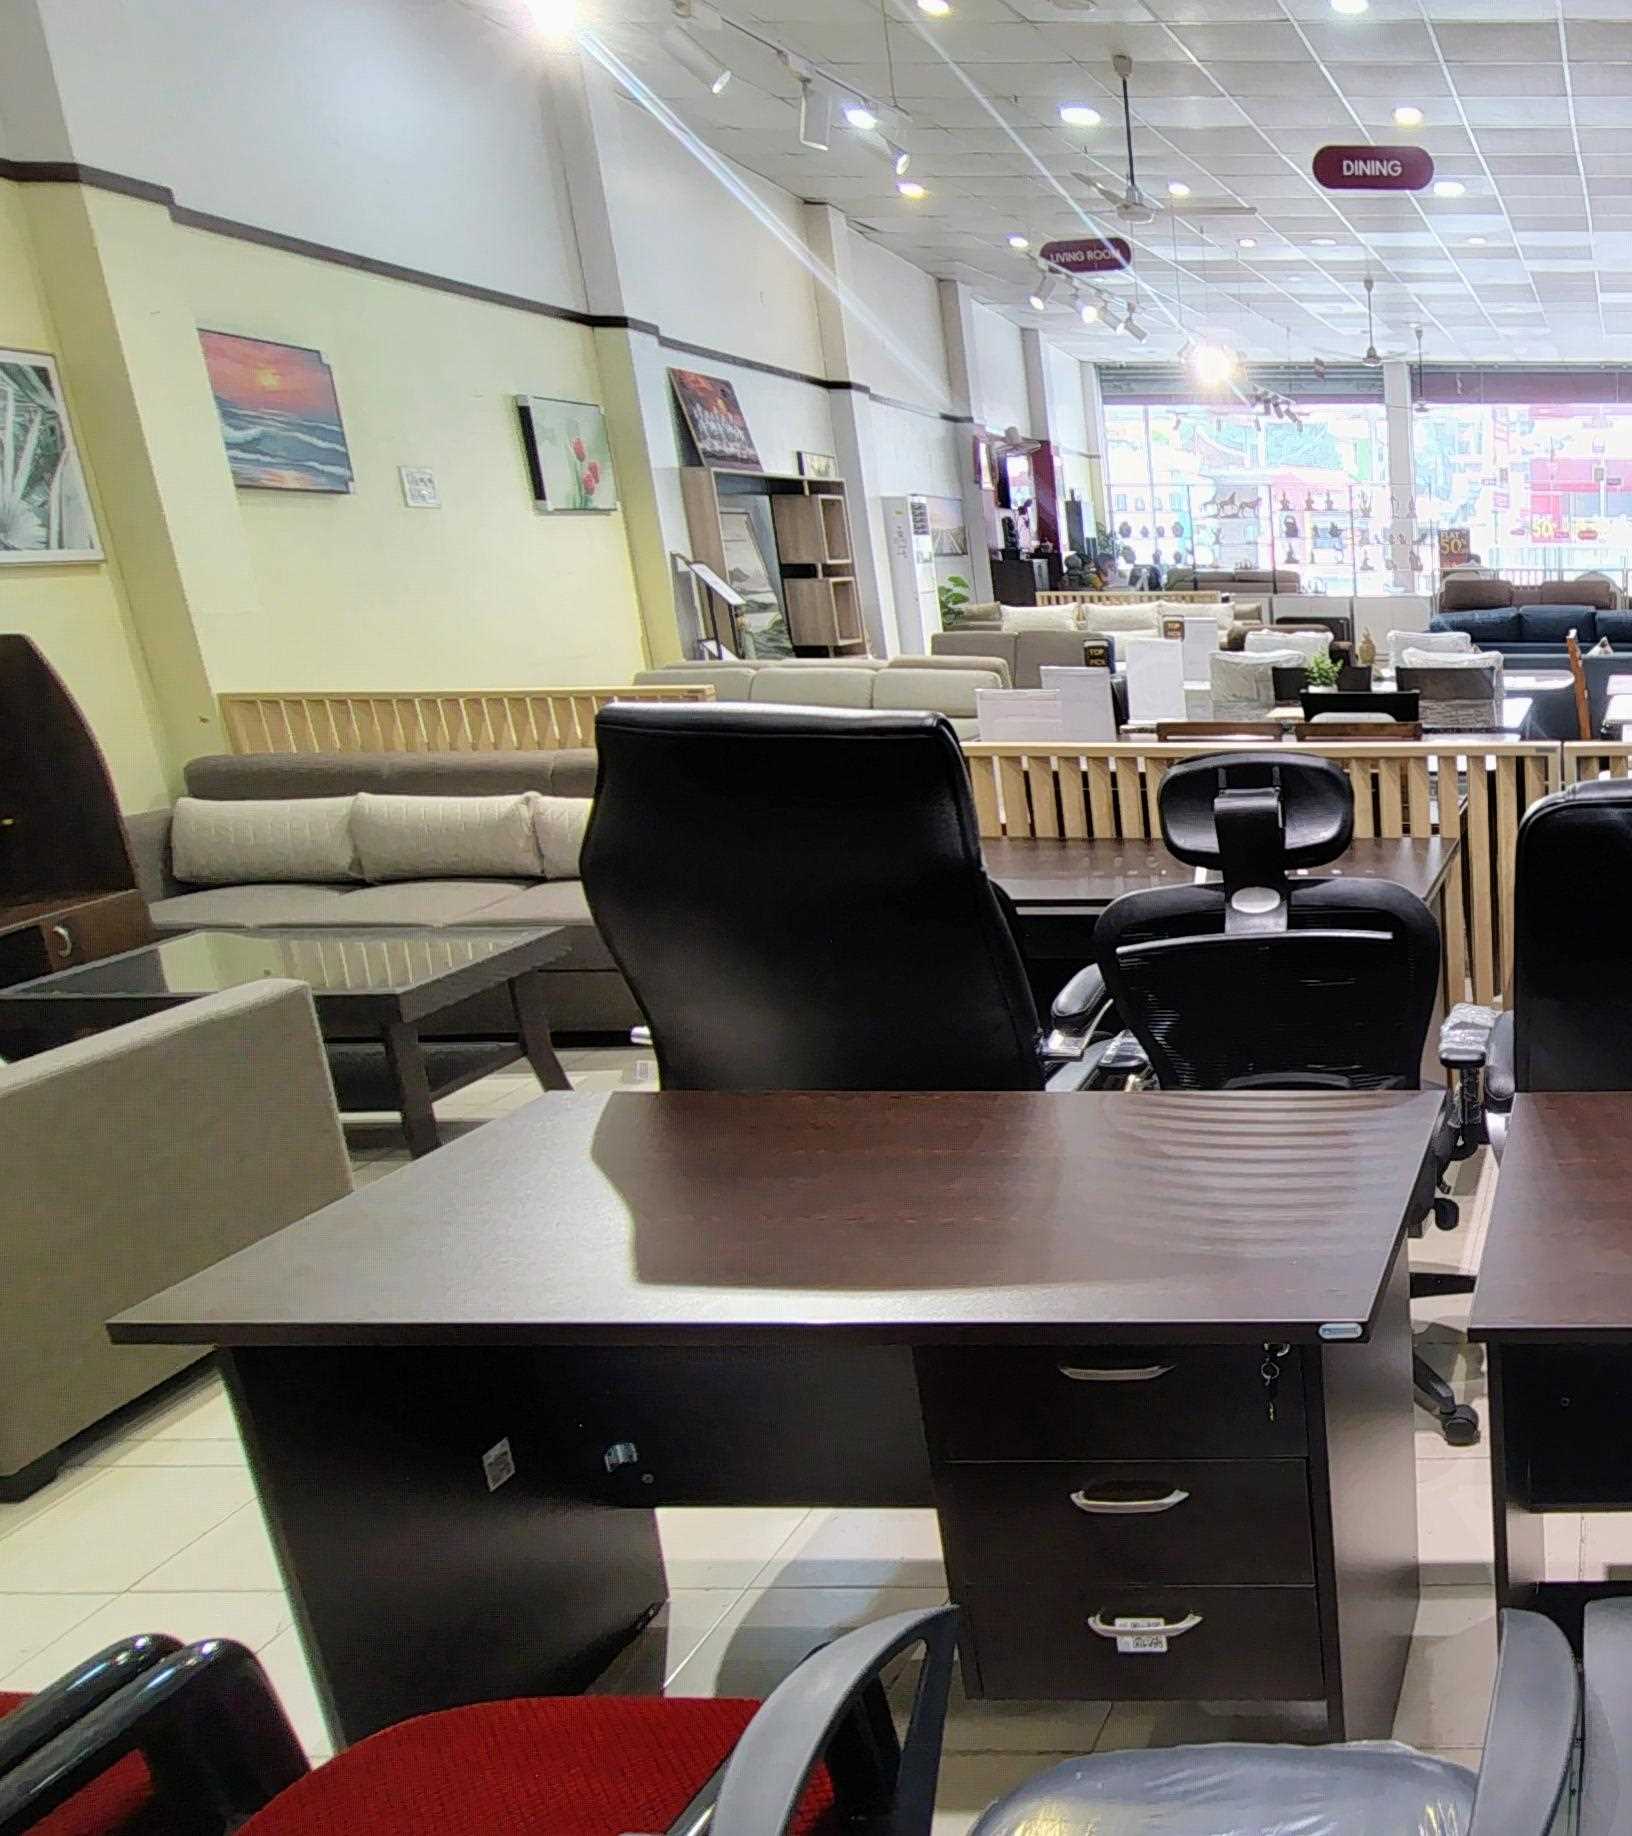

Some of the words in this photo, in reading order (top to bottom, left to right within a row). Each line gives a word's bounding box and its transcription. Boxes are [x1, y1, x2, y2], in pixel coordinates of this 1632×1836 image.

[1343, 160, 1402, 176] DINING
[1050, 251, 1085, 263] LIVING
[1089, 648, 1104, 656] TOP
